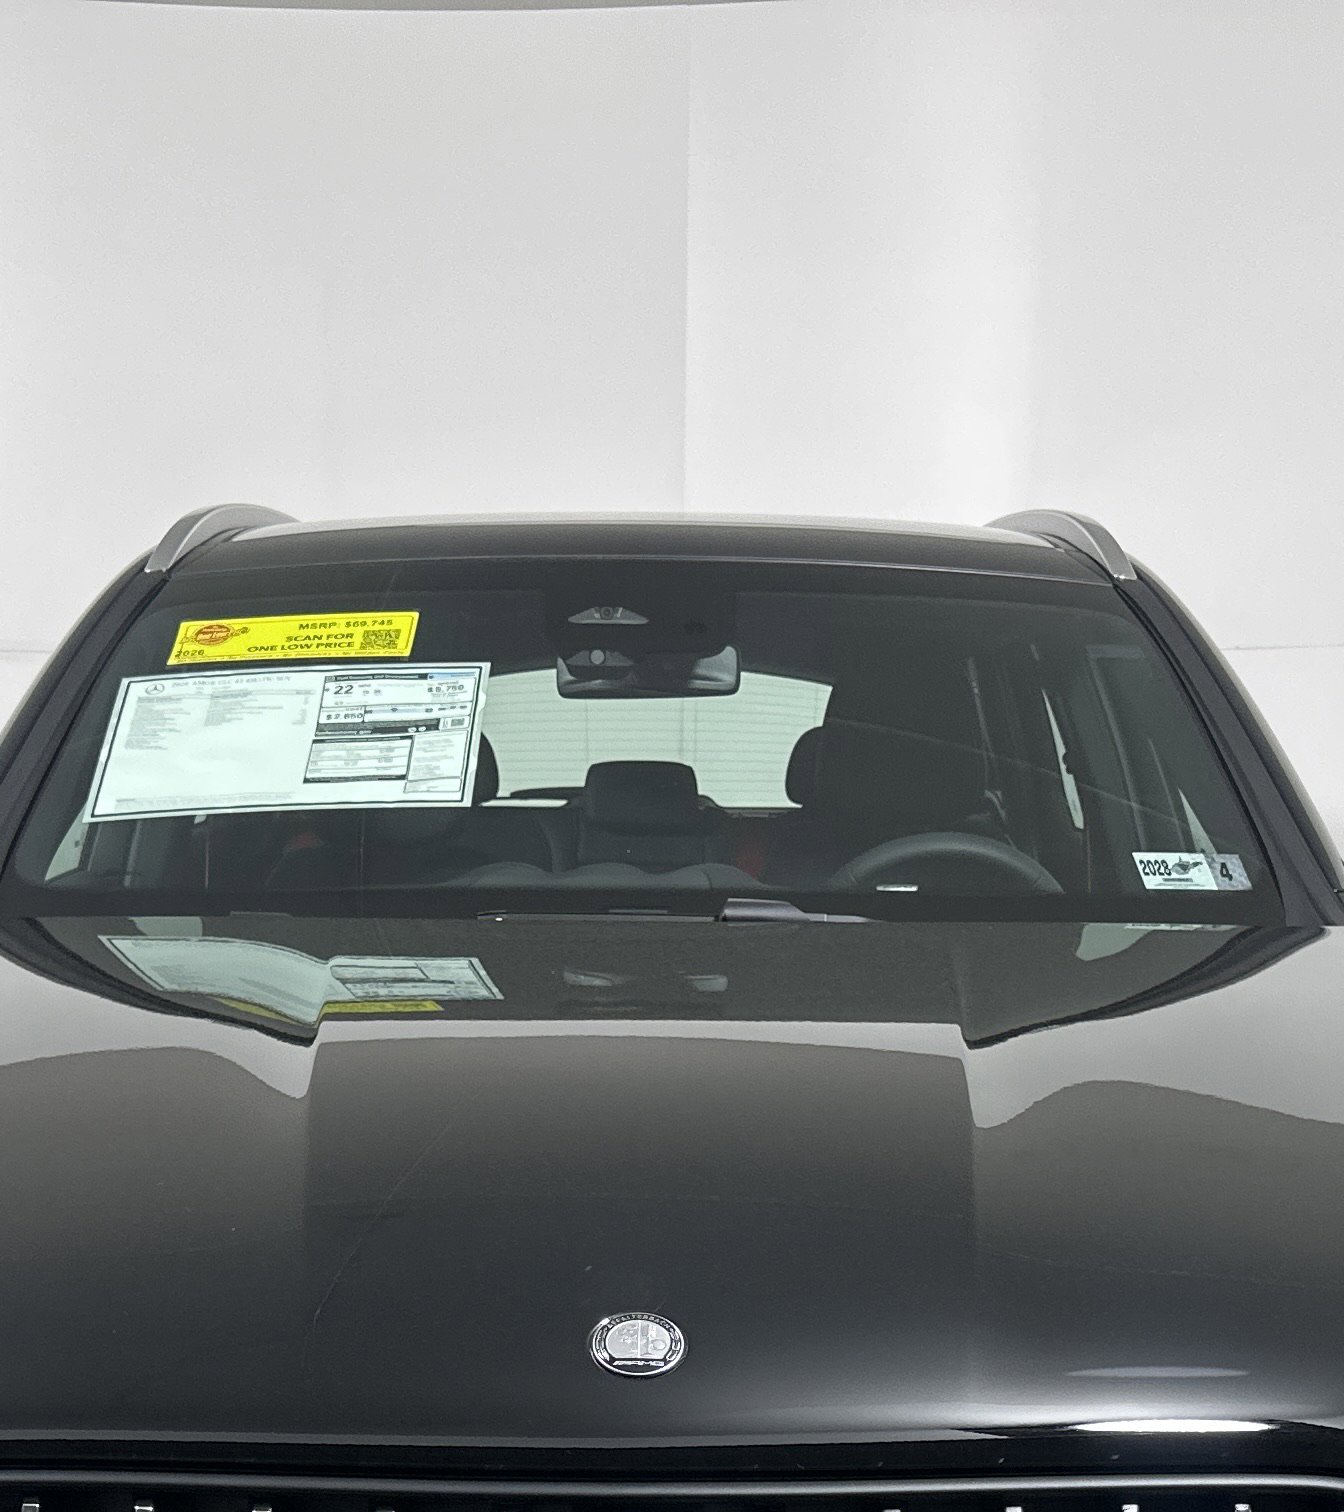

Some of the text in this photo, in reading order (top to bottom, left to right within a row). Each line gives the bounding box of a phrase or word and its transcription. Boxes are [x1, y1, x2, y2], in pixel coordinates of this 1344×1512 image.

[285, 632, 354, 642] SCAN FOR
[246, 641, 355, 653] ONE LOW PRICE
[333, 684, 354, 695] 22
[1138, 859, 1173, 877] 2028
[1219, 862, 1234, 882] 4
